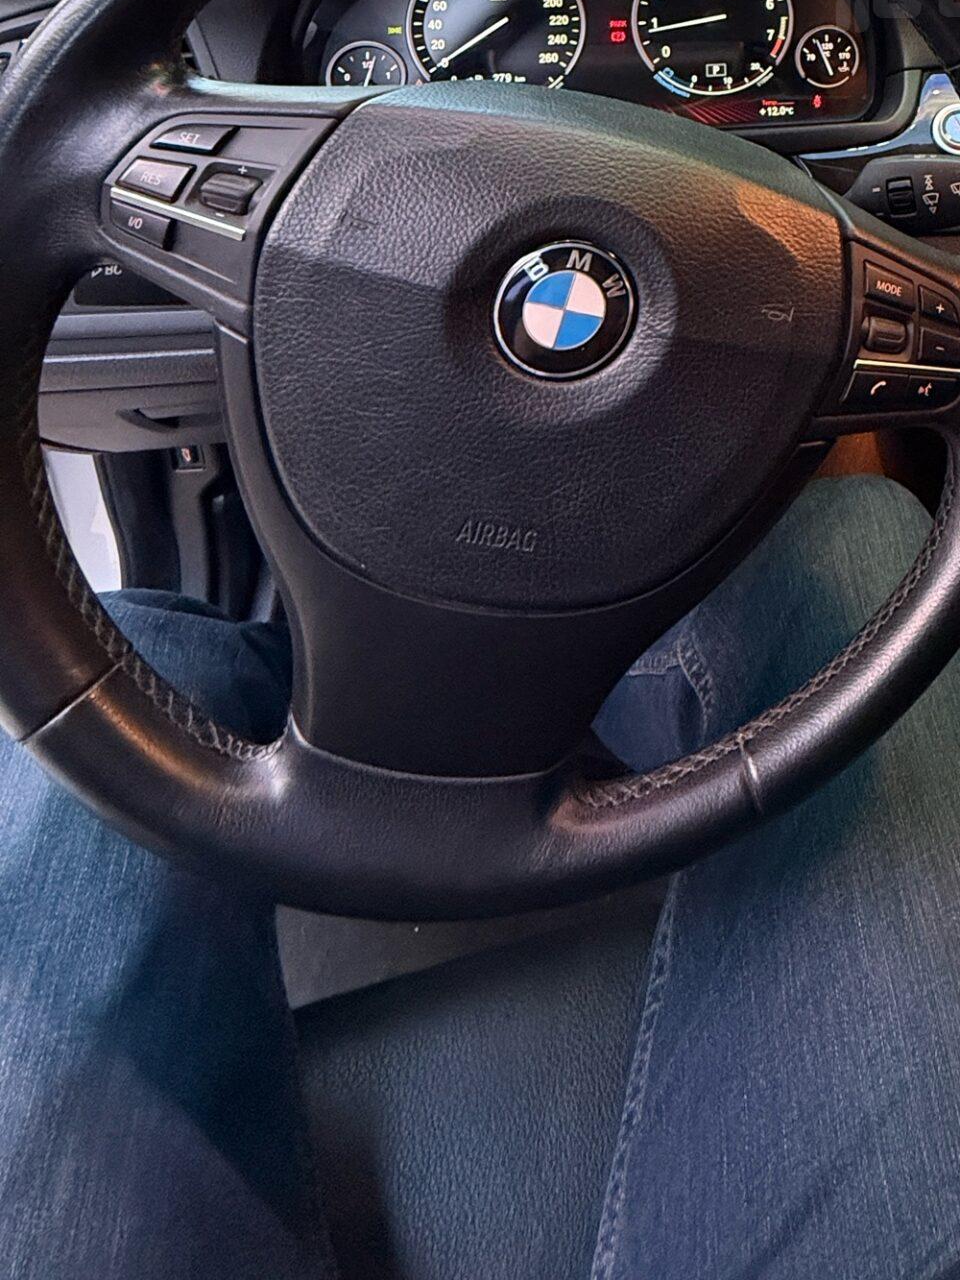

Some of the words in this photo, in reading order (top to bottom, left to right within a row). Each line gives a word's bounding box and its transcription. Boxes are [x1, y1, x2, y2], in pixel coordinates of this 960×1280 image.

[432, 1, 448, 12] 60
[428, 19, 442, 31] 40
[549, 15, 569, 26] 220
[547, 34, 568, 45] 240
[766, 30, 775, 41] 7
[431, 39, 445, 50] 20
[661, 46, 671, 57] 0
[538, 53, 559, 64] 260
[179, 131, 200, 144] SET
[140, 171, 161, 185] RES
[523, 249, 626, 298] BMW
[875, 280, 902, 297] MODE
[456, 520, 538, 552] AIRBAG
